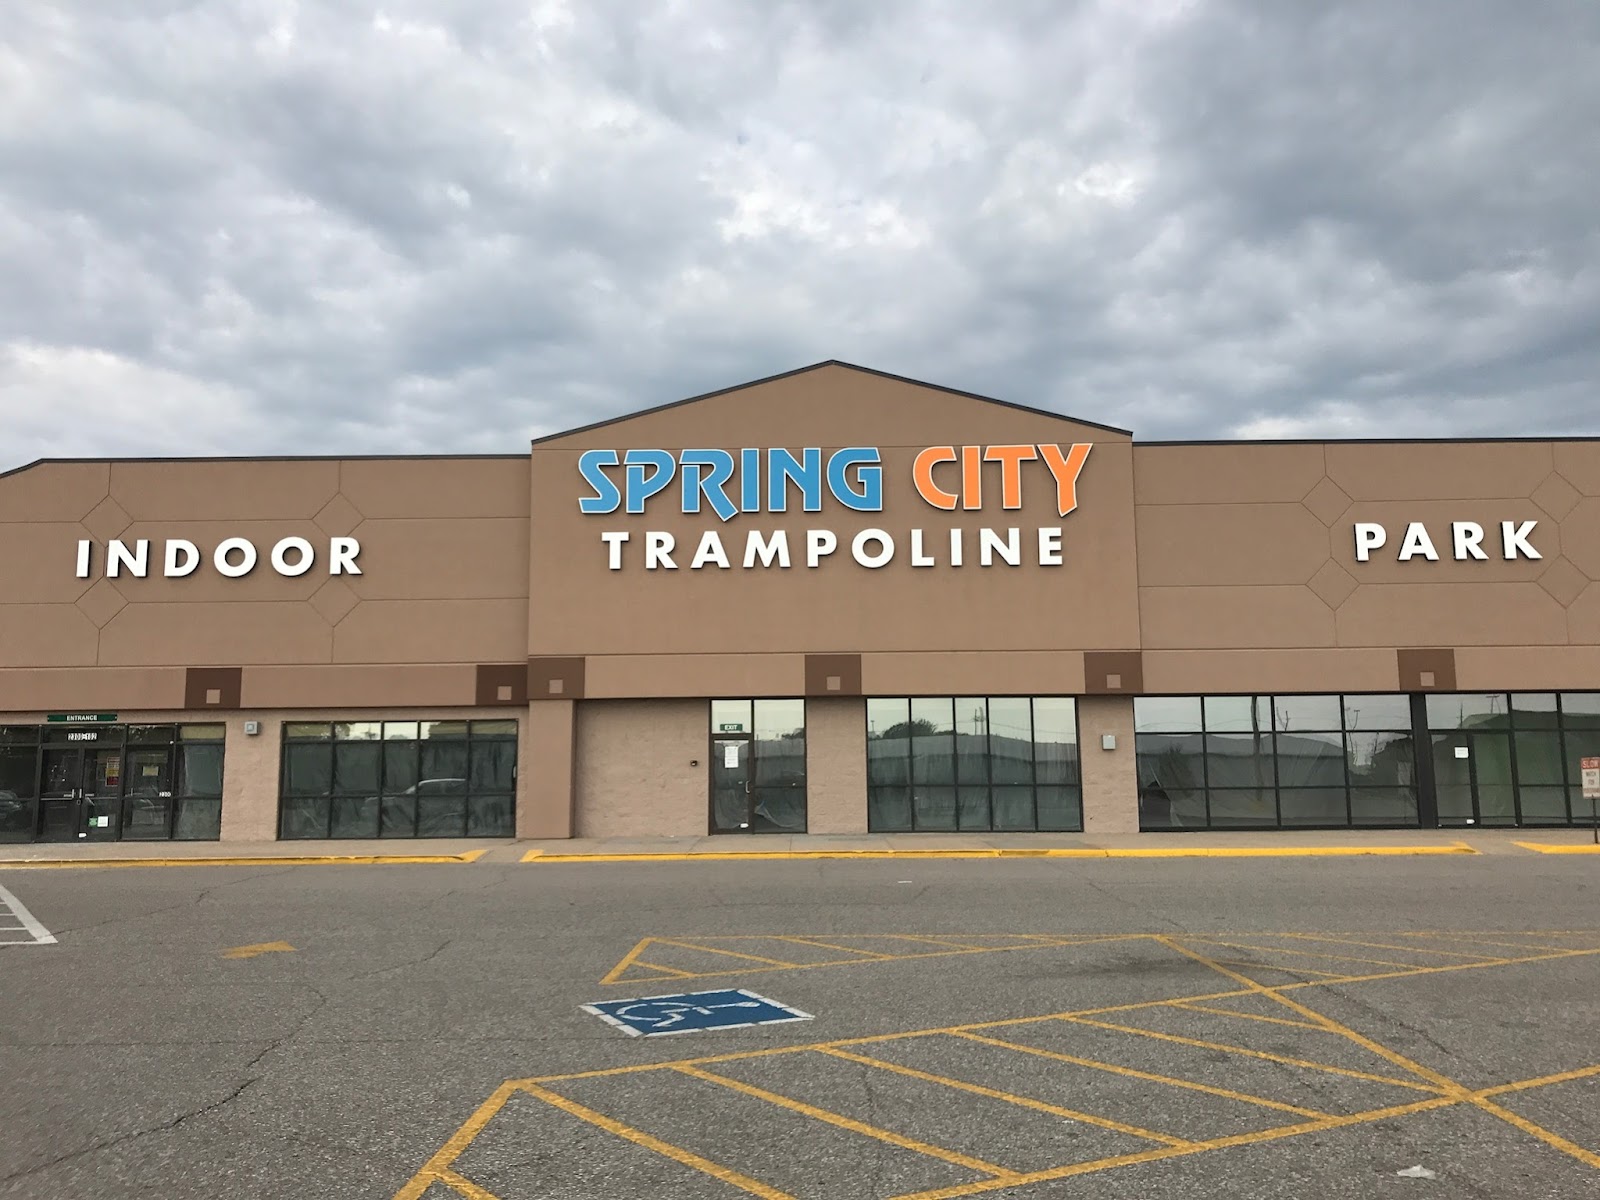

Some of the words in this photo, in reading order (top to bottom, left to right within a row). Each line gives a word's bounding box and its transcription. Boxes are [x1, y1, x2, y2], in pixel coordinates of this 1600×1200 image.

[578, 447, 883, 522] SPRING
[912, 443, 1093, 517] CITY
[76, 536, 362, 577] INDOOR
[601, 527, 1063, 569] TRAMPOLINE
[1355, 520, 1543, 561] PARK
[1582, 760, 1599, 768] SLOW
